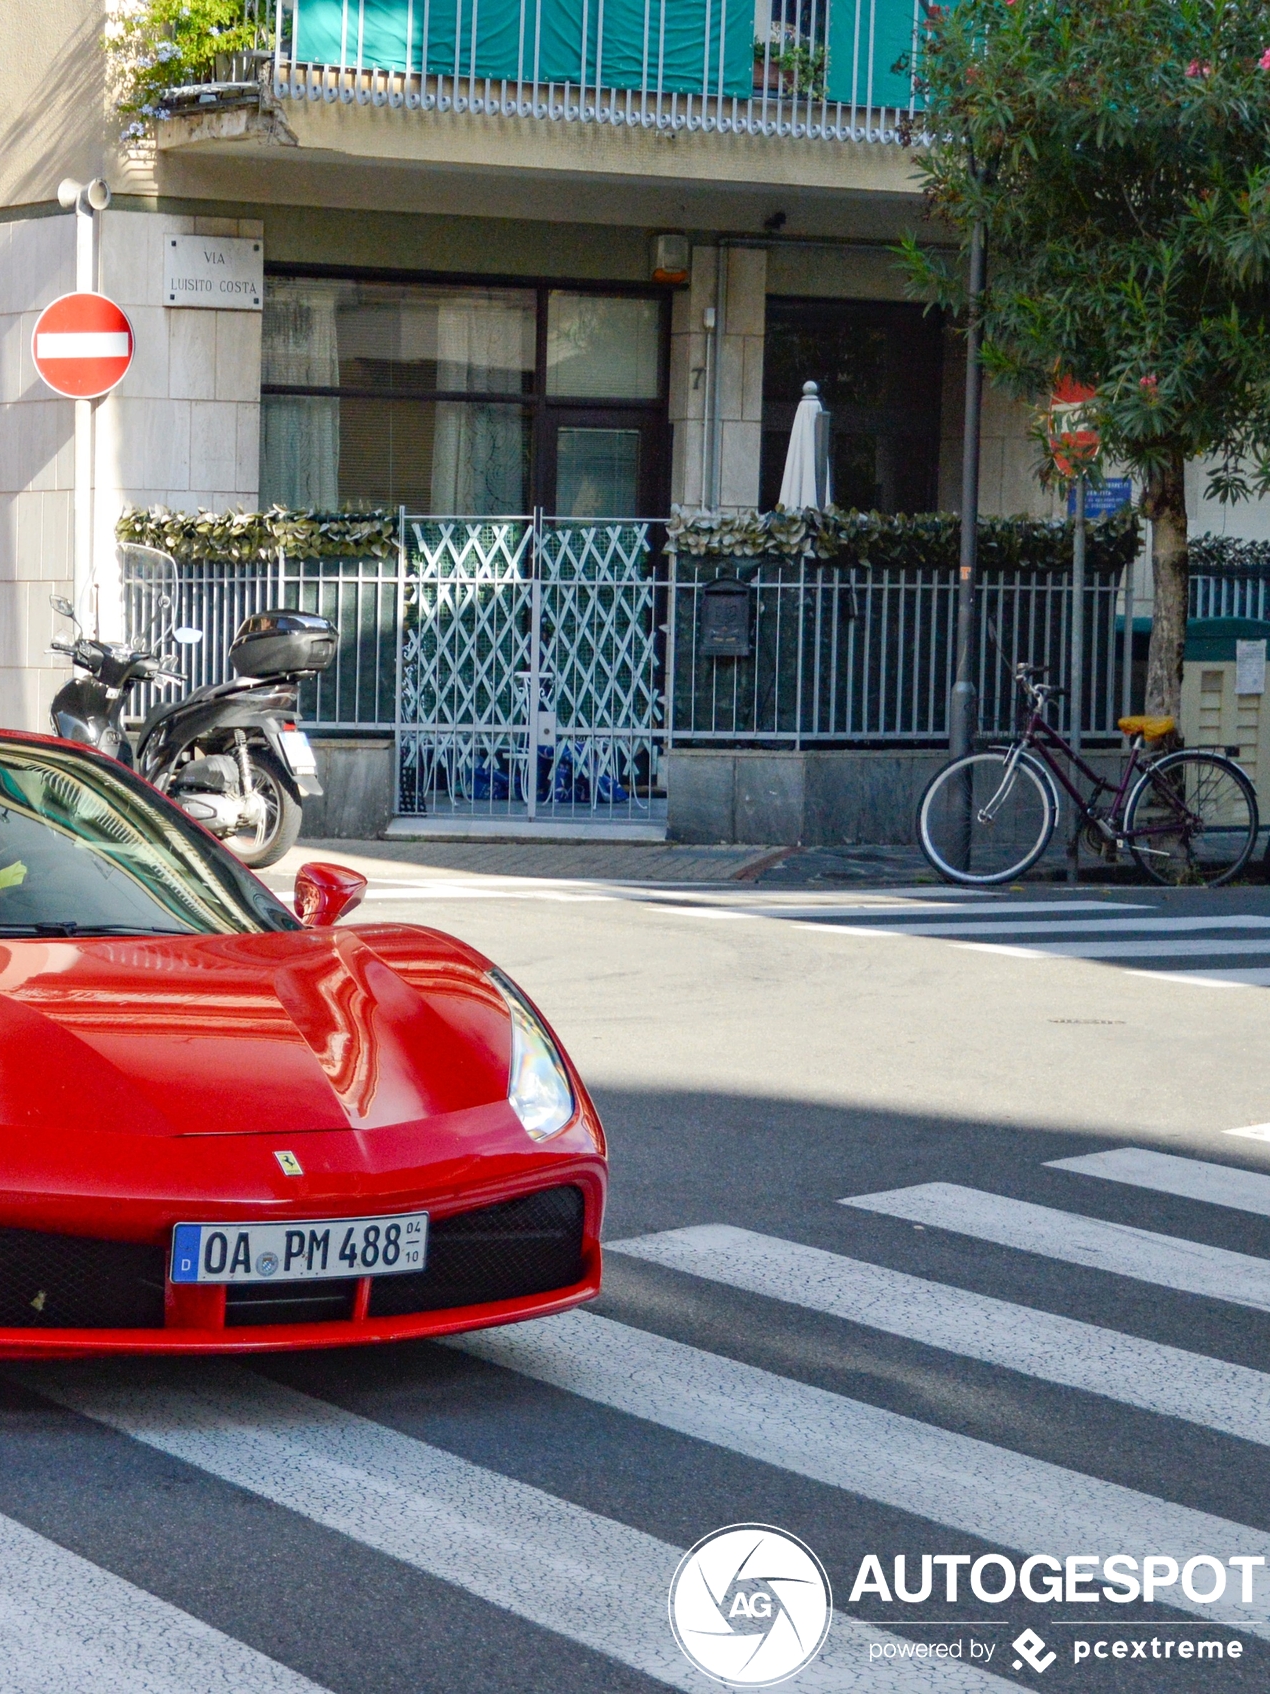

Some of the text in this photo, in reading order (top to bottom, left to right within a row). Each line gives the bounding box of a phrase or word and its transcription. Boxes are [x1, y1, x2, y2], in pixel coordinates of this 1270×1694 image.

[204, 251, 225, 264] VIA
[171, 278, 256, 294] LUISITO COSTA
[691, 367, 706, 389] 7
[406, 1221, 421, 1234] 04
[181, 1223, 401, 1274] D OA PM 488
[406, 1250, 419, 1263] 10
